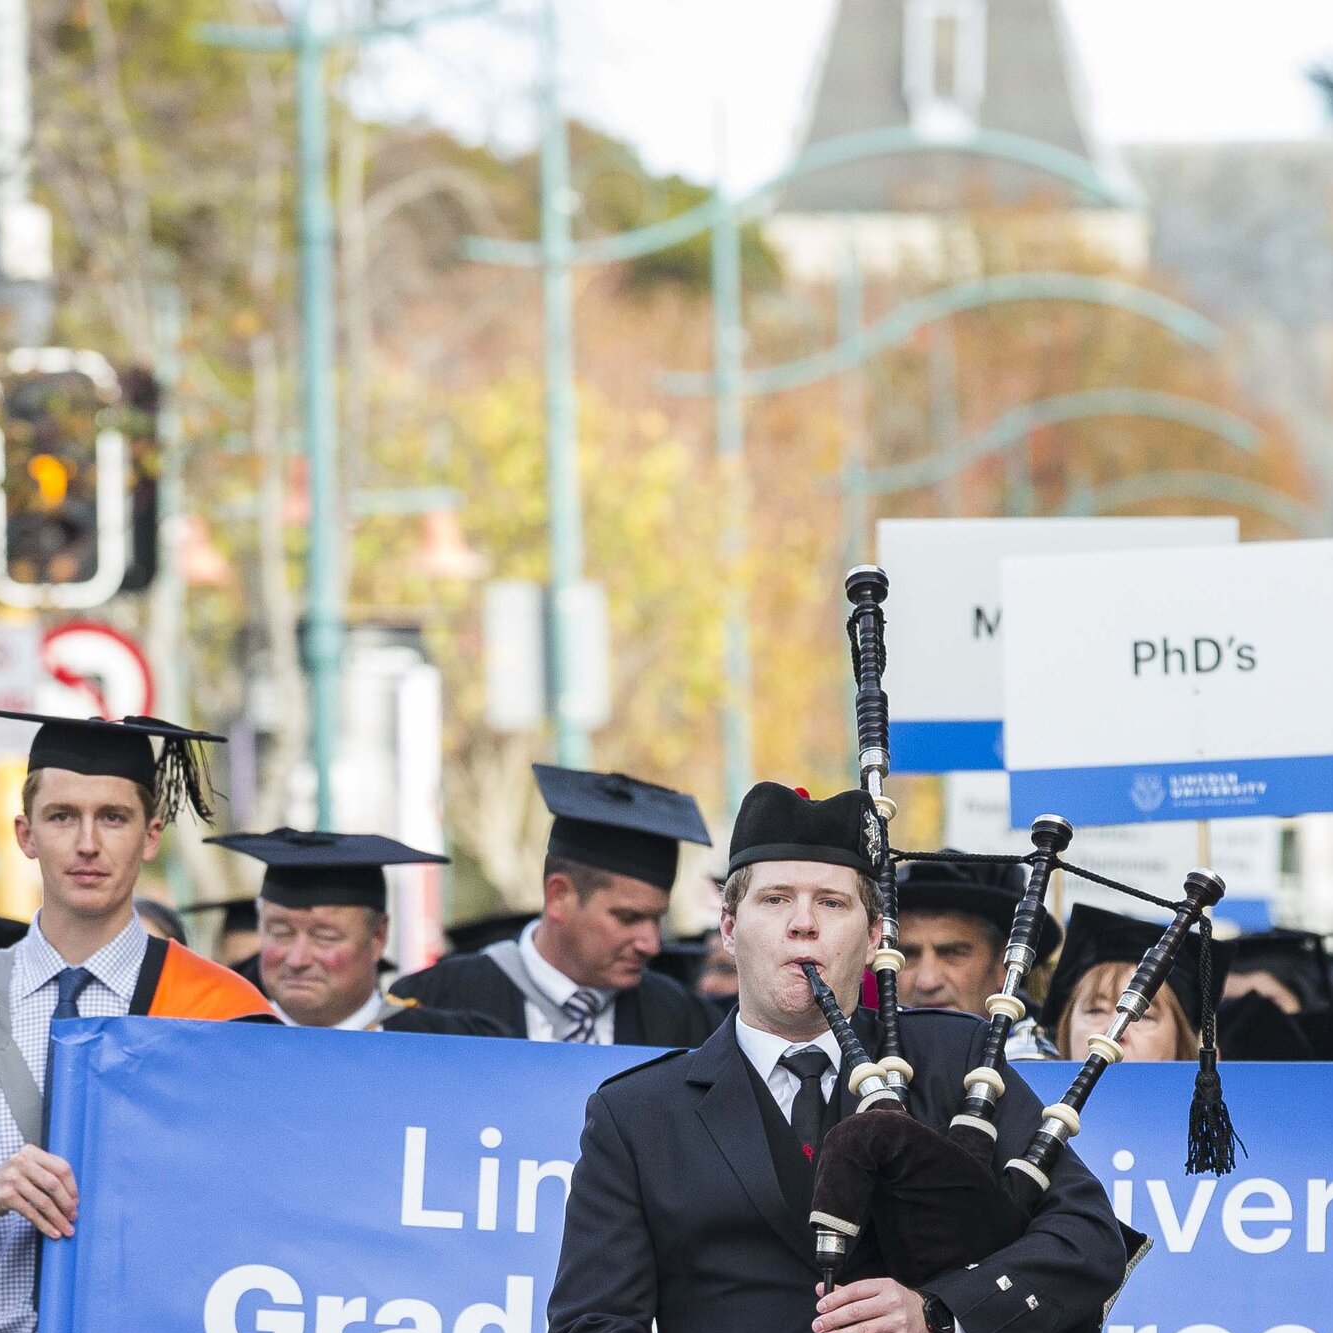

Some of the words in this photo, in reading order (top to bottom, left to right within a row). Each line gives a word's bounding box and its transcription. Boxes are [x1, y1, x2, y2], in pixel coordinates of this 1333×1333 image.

[1132, 635, 1259, 677] PhD's
[1169, 771, 1239, 788] LINCOLN
[1169, 780, 1267, 799] UNIVERSITY
[400, 1125, 575, 1234] Lin
